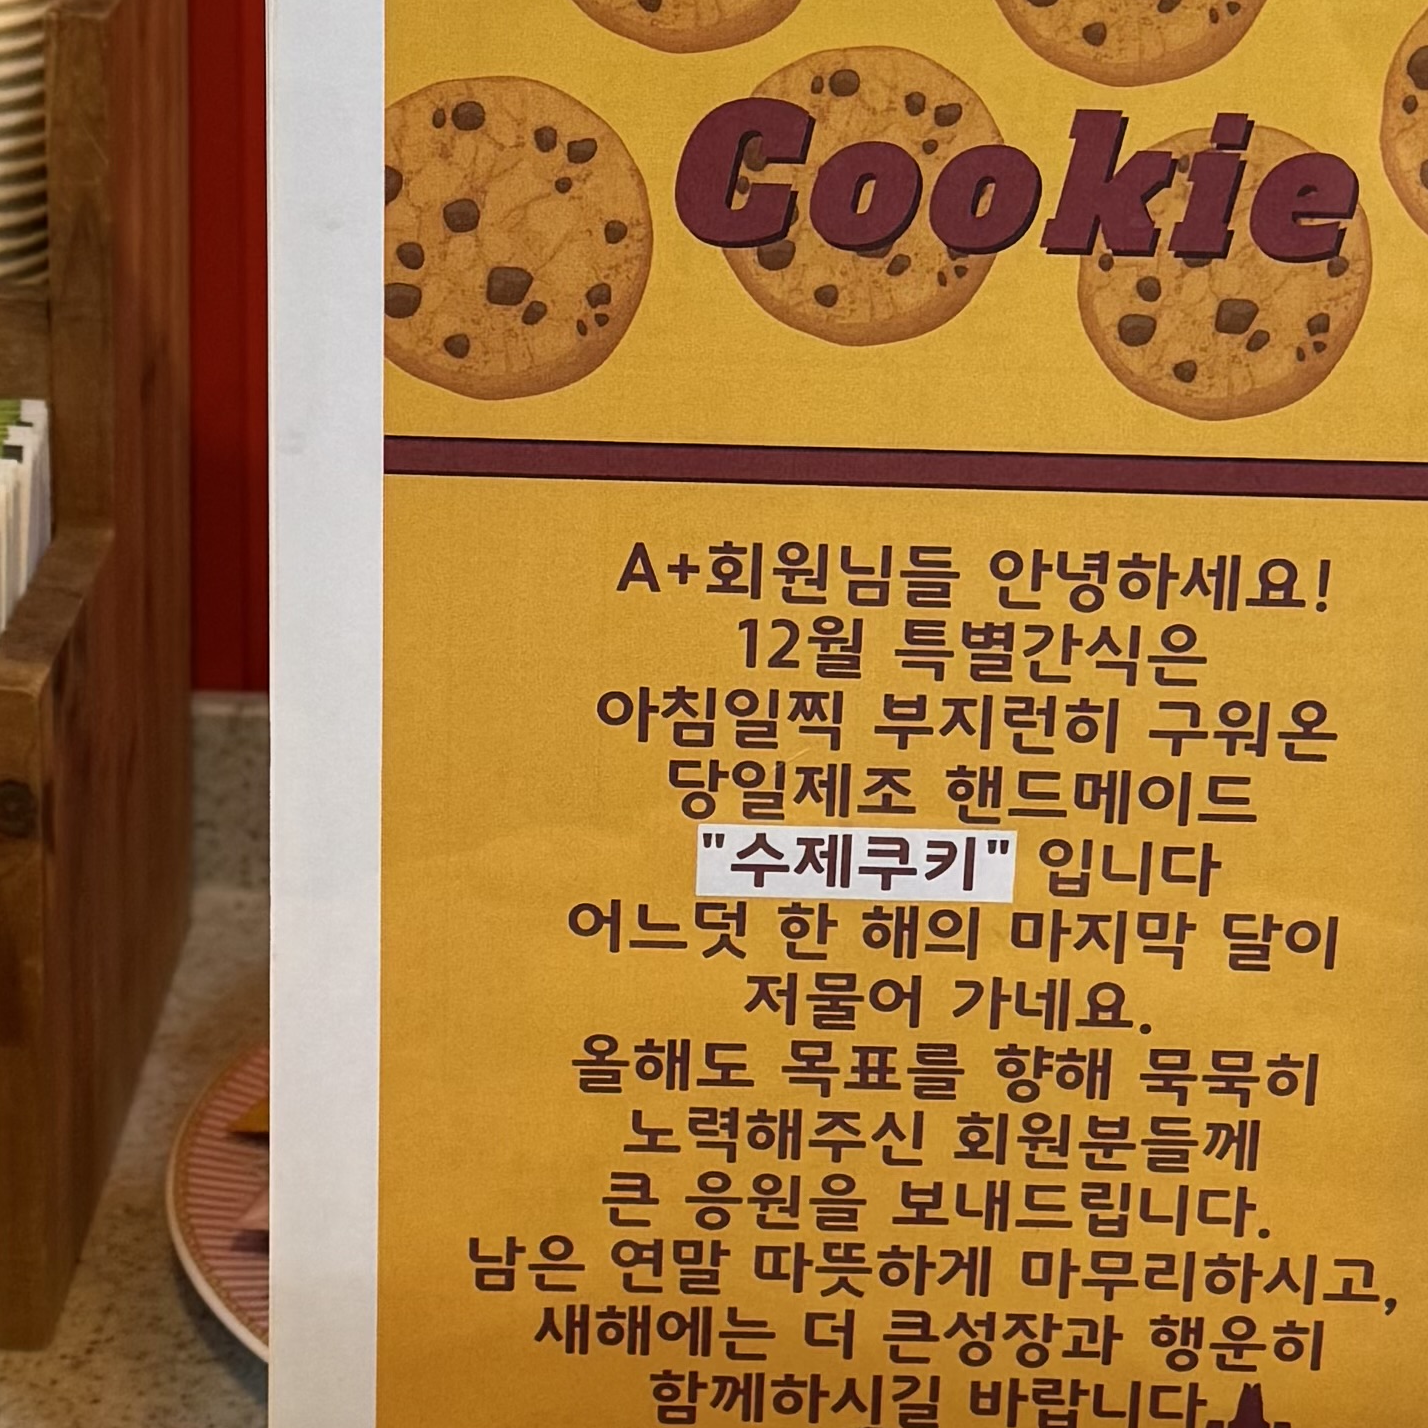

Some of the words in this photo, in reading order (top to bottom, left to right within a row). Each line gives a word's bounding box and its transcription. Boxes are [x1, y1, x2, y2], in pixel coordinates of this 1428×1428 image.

[674, 97, 1359, 264] Cookie
[617, 541, 960, 608] A+회원님들
[990, 549, 1330, 612] 안녕하세요!
[739, 616, 863, 678] 12월
[895, 620, 1207, 686] 특별간식은
[597, 686, 843, 751] 아침일찍
[875, 694, 1119, 754] 부지런히
[1149, 701, 1337, 762] 구워온
[669, 760, 916, 820] 당일제조
[946, 765, 1257, 826] 핸드메이드
[703, 833, 1009, 890] "수제쿠키"
[1040, 839, 1221, 897] 입니다
[569, 899, 746, 959] 어느덧
[778, 902, 838, 960] 한
[863, 906, 979, 960] 해의
[1011, 909, 1196, 969] 마지막
[1223, 914, 1338, 971] 달이
[744, 973, 921, 1030] 저물어
[953, 977, 1151, 1034] 가네요.
[572, 1034, 754, 1093] 올해도
[782, 1040, 964, 1100] 목표를
[995, 1044, 1112, 1103] 향해
[1140, 1049, 1318, 1108] 묵묵히
[624, 1107, 924, 1166] 노력해주신
[954, 1112, 1260, 1173] 회원분들께
[602, 1172, 659, 1227] 큰
[685, 1171, 867, 1231] 응원을
[892, 1180, 1270, 1238] 보내드립니다.
[469, 1235, 585, 1292] 남은
[611, 1239, 730, 1295] 연말
[755, 1242, 991, 1298] 따뜻하게
[1022, 1248, 1397, 1315] 마무리하시고,
[534, 1304, 776, 1361] 새해에는
[805, 1309, 855, 1360] 더
[883, 1310, 1123, 1368] 큰성장과
[1150, 1314, 1324, 1372] 행운히
